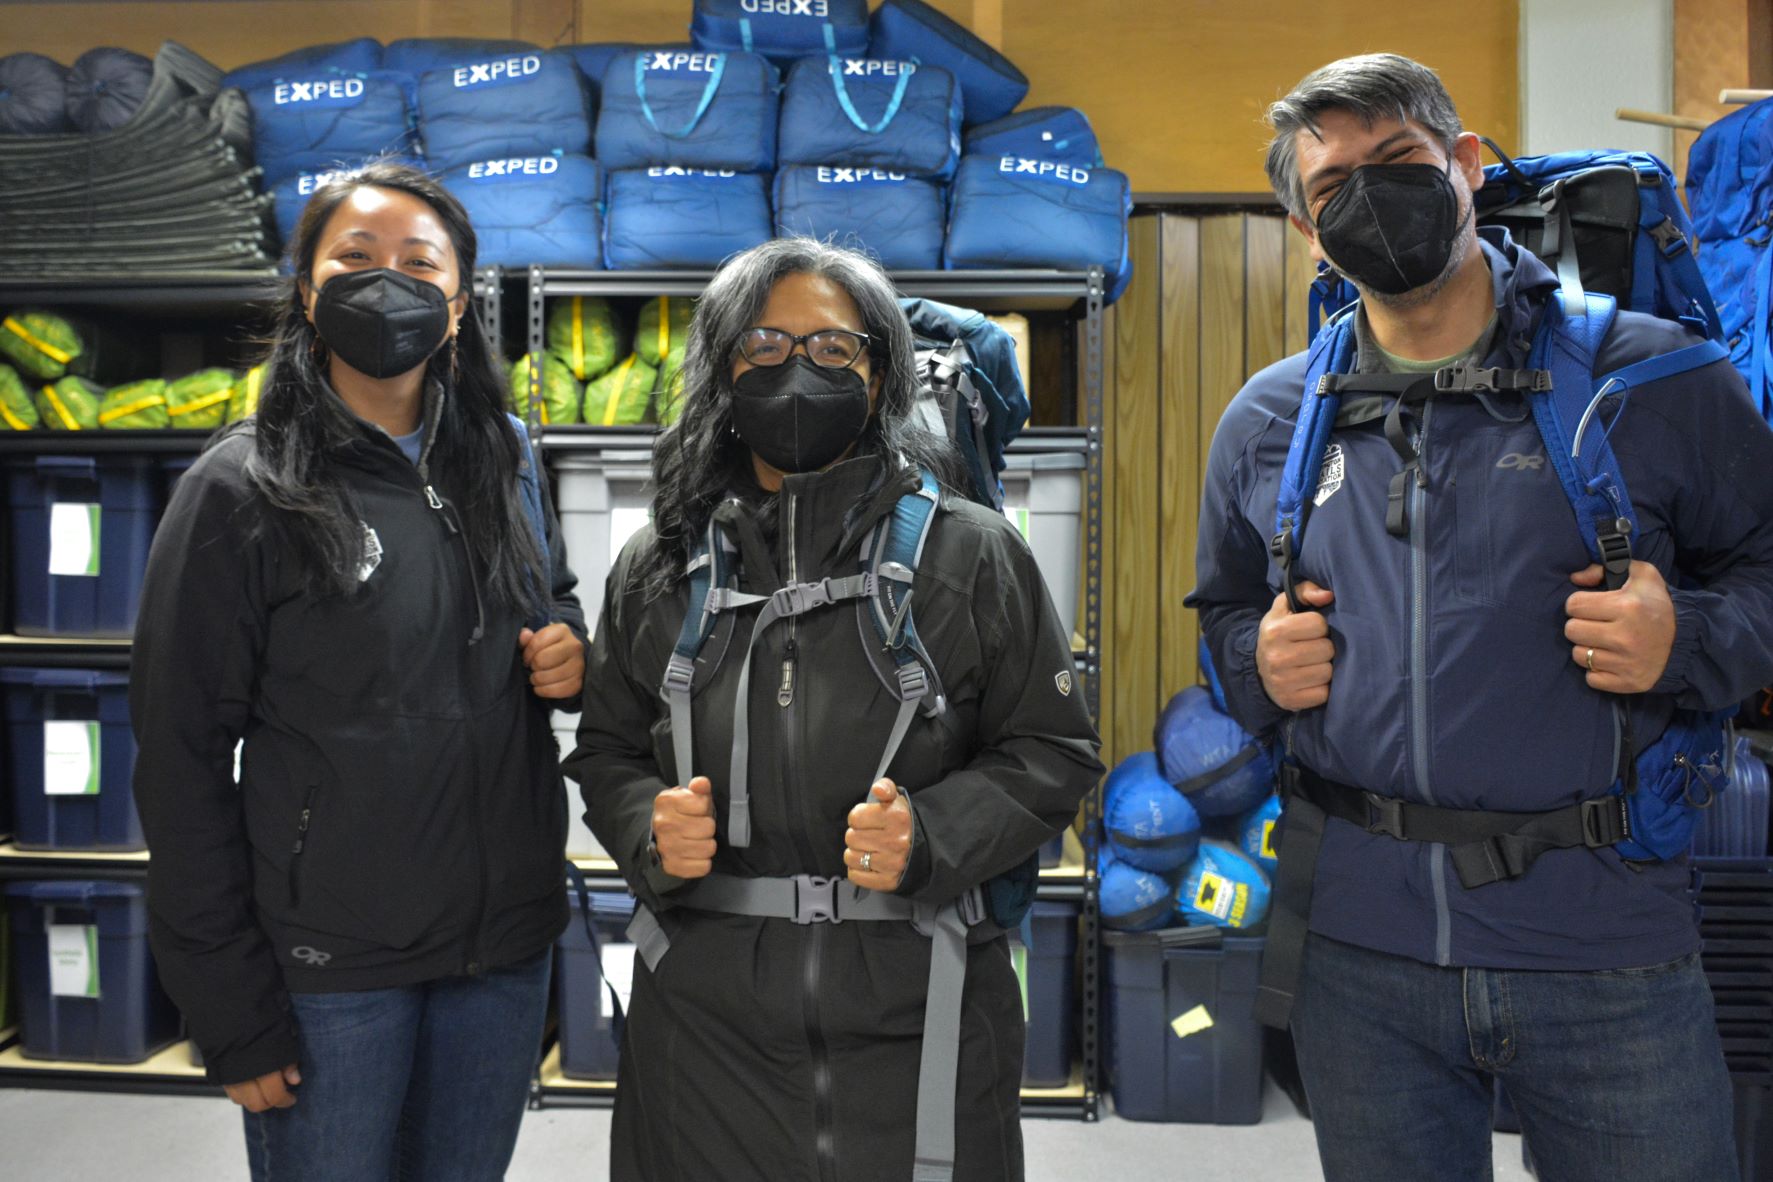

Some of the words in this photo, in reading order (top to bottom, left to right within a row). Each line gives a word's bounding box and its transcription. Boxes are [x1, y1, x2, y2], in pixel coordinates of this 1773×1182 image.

[740, 0, 829, 17] EXPED
[454, 56, 541, 88] EXPED
[274, 79, 364, 105] EXPED
[468, 157, 559, 178] EXPED
[1000, 156, 1089, 184] EXPED
[1495, 453, 1545, 470] OR
[291, 946, 332, 966] OR
